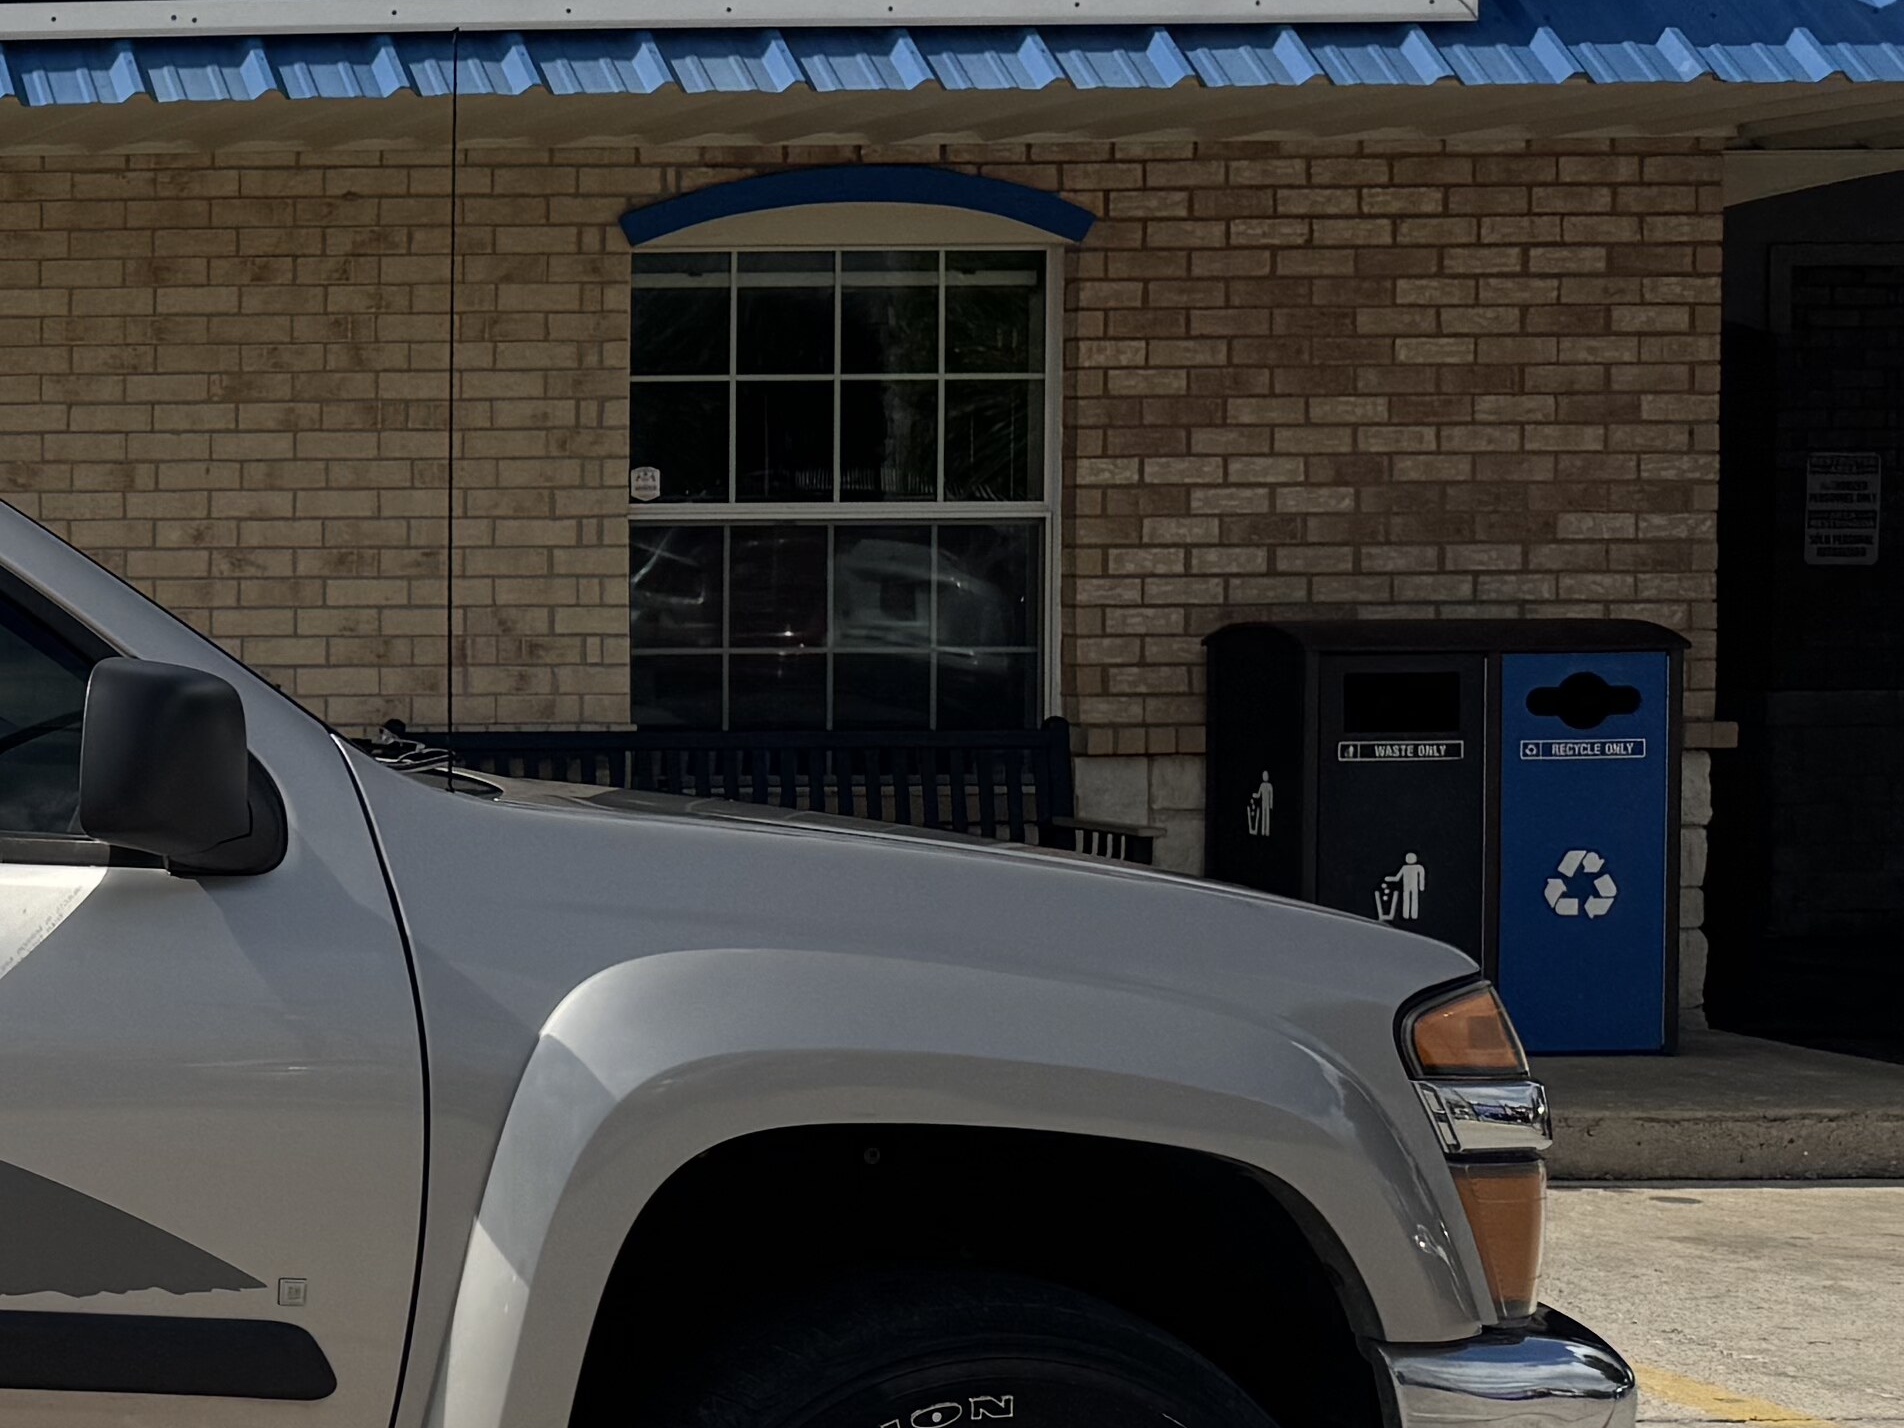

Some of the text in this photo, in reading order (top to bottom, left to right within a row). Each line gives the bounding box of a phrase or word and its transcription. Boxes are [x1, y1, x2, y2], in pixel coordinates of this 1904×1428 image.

[1374, 744, 1446, 757] WASTE ONLY
[1551, 742, 1634, 756] RECYCLE ONLY
